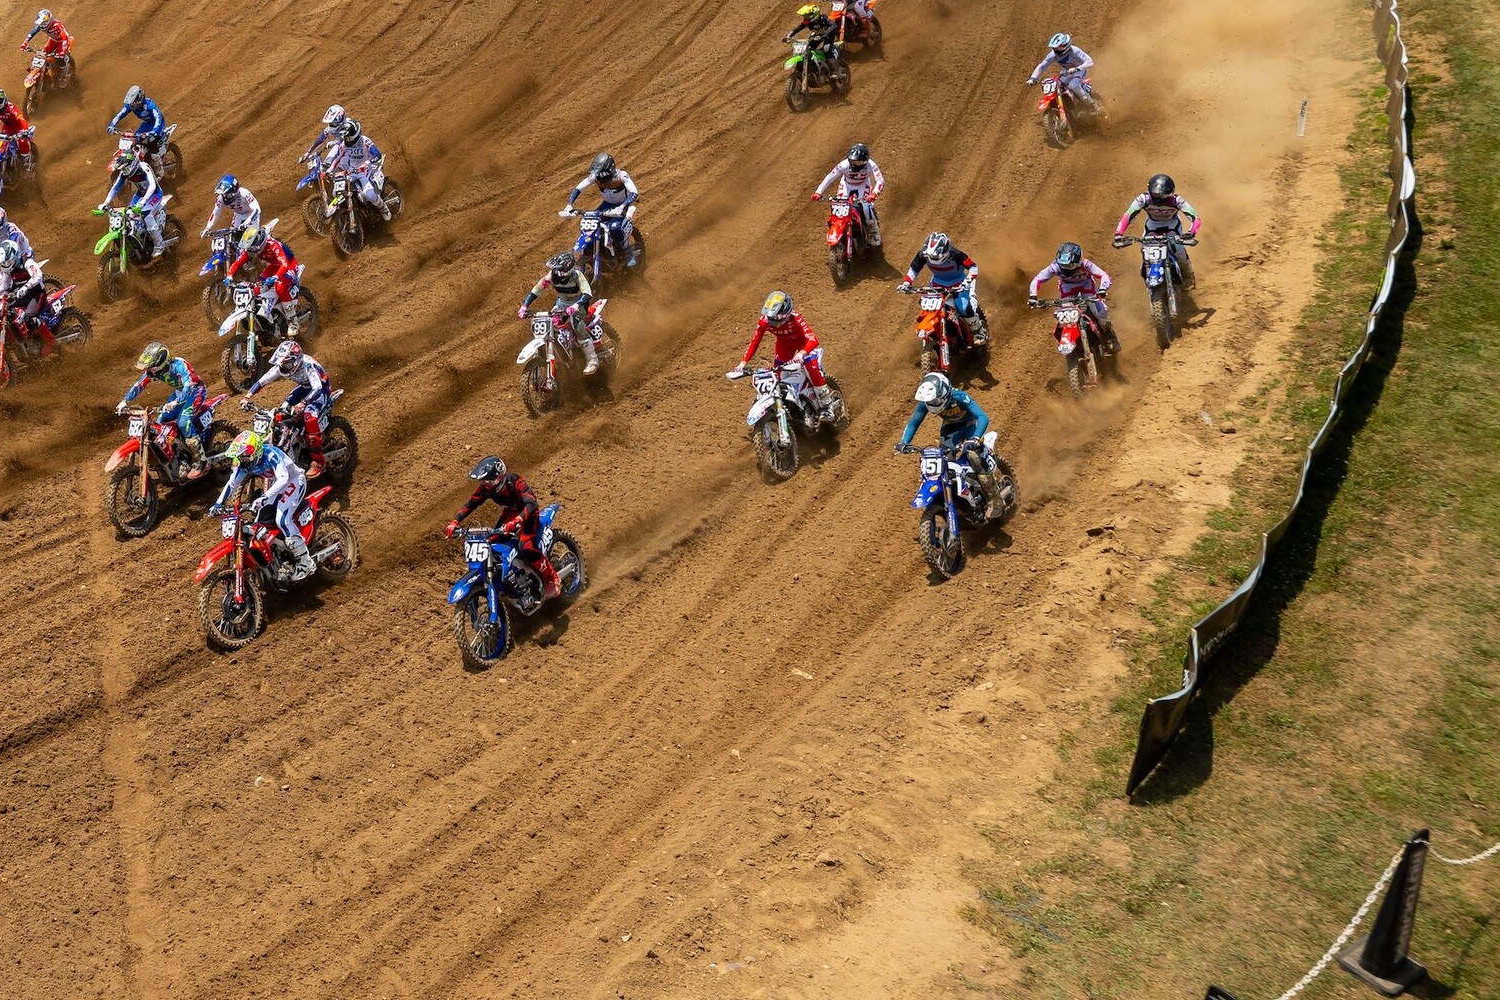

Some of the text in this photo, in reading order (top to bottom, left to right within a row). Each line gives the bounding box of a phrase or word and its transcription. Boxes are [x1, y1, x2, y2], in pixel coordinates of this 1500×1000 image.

[1043, 81, 1057, 94] 91
[831, 205, 850, 217] 736
[110, 216, 126, 230] 98
[920, 297, 942, 310] 991
[533, 321, 547, 334] 99
[590, 325, 603, 340] 99
[199, 411, 213, 428] 682
[920, 458, 942, 474] 451
[298, 508, 313, 527] 195
[538, 527, 553, 555] 245
[465, 543, 489, 562] 245
